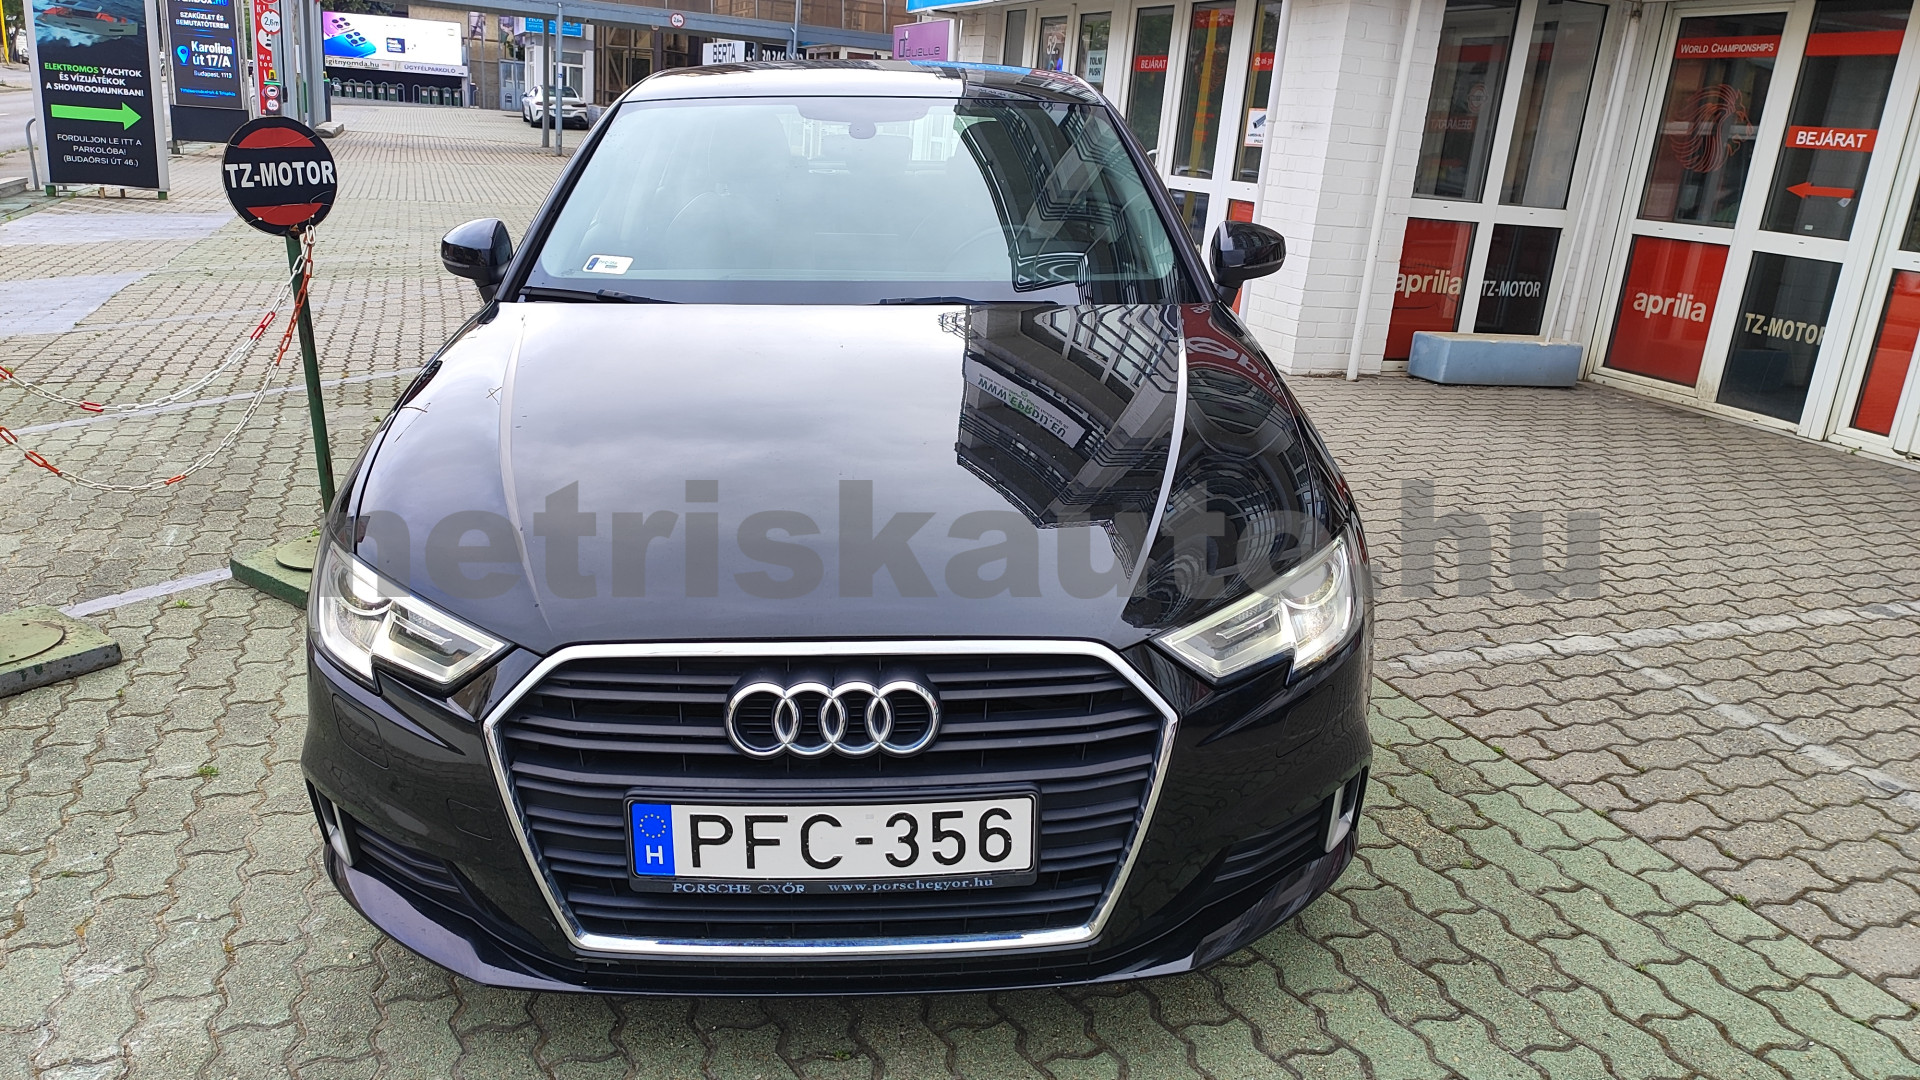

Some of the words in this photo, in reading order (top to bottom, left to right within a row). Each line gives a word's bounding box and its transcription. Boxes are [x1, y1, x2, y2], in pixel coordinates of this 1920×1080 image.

[190, 40, 233, 55] Karolina
[712, 43, 736, 63] BERTA
[192, 53, 205, 66] út
[205, 55, 231, 68] 17/A
[325, 58, 380, 69] igitnyomda.hu
[1140, 57, 1167, 69] BEJÁRAT
[44, 62, 99, 74] ELEKTROMOS
[100, 66, 142, 78] YACHTOK
[59, 72, 69, 81] ÉS
[404, 64, 456, 74] ÜGYFÉLPARKOLÓ
[46, 82, 53, 90] A
[53, 83, 144, 97] SHOWROOMUNKBAN!
[57, 133, 107, 144] FORDULJON
[108, 137, 119, 145] LE
[120, 138, 134, 146] ITT
[1795, 130, 1867, 148] BEJÁRAT
[110, 156, 122, 166] ÚT
[224, 160, 336, 189] TZ-MOTOR
[1395, 269, 1463, 299] aprilia
[1481, 280, 1541, 298] TZ-MOTOR
[1633, 292, 1707, 322] aprilia
[646, 845, 664, 865] H
[690, 808, 1013, 870] PFC-356
[673, 883, 752, 893] PORSCHE
[828, 877, 994, 892] www.porschegyor.hu
